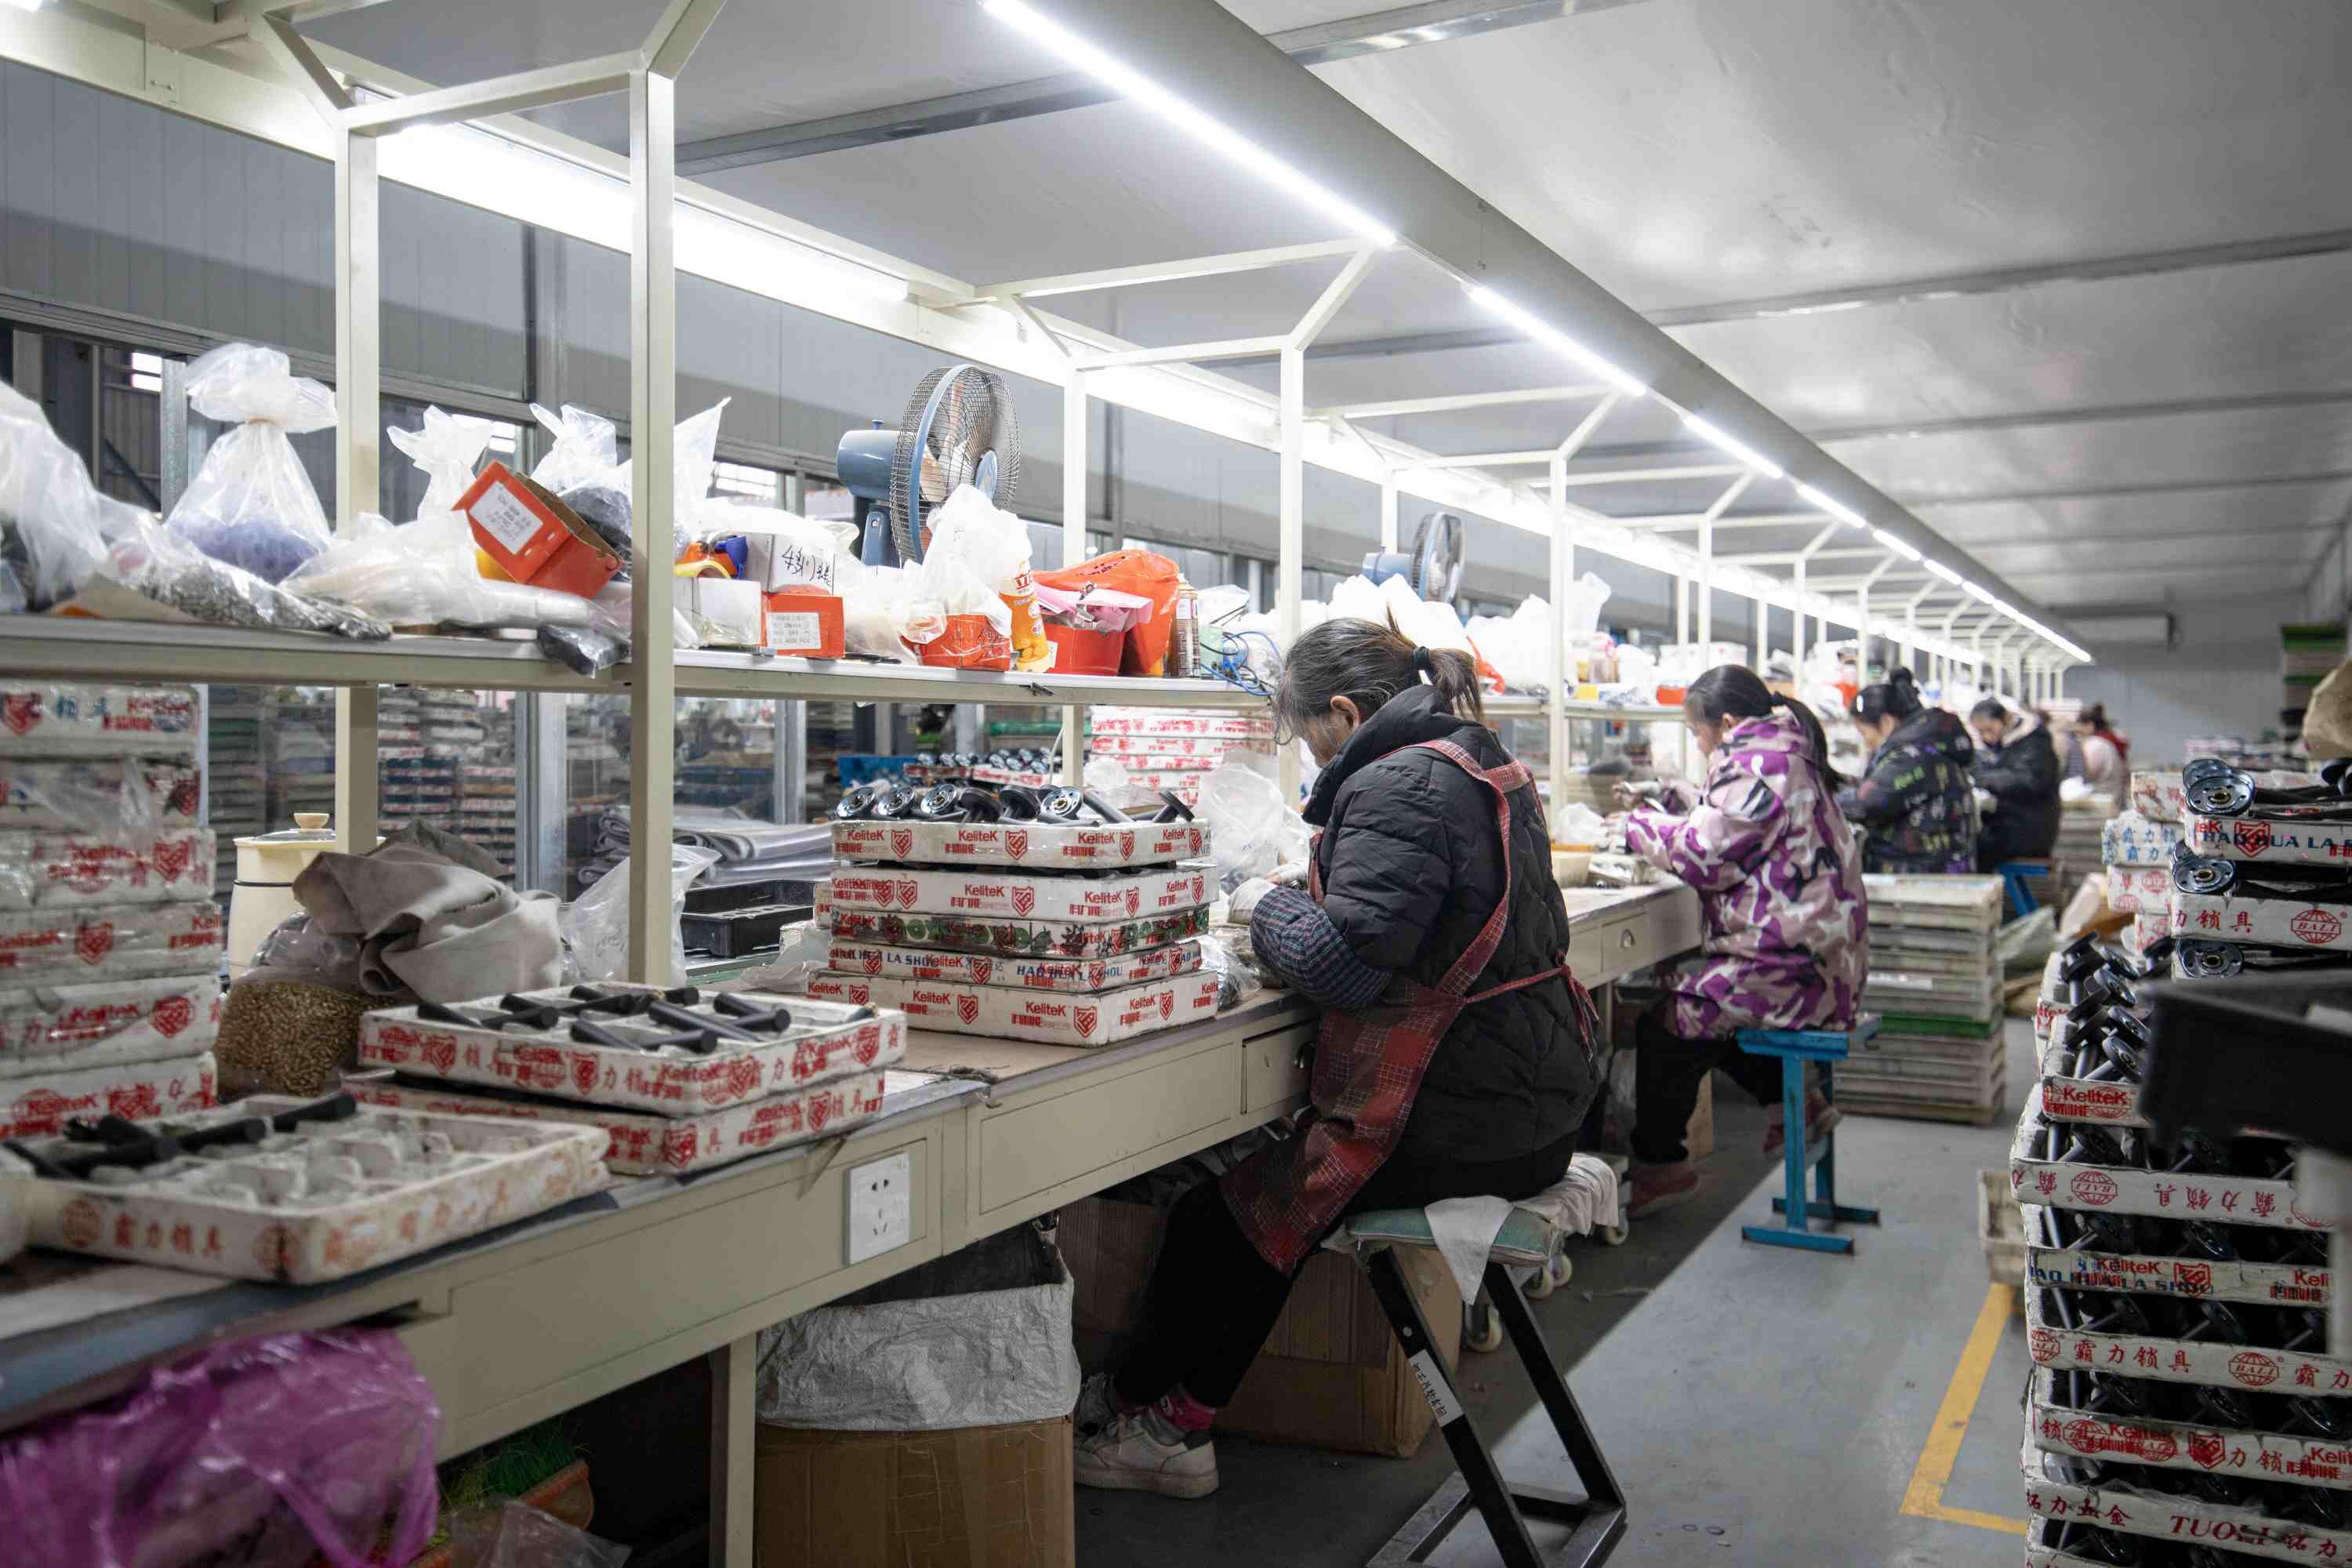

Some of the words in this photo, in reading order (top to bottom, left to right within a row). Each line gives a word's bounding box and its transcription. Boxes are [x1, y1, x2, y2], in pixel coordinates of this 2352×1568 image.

[848, 829, 885, 841] KeliteK
[959, 829, 998, 842] KeliteK
[1078, 831, 1116, 844] KeliteK
[965, 884, 1004, 898] KeliteK
[1084, 891, 1122, 904] KeliteK
[2297, 921, 2336, 932] BALI
[808, 982, 843, 995] KeliteK
[913, 990, 951, 1004] KeliteK
[1129, 994, 1156, 1011] KeliteK
[1025, 1001, 1067, 1017] KeliteK
[2063, 1087, 2129, 1105] KeliteK
[2076, 1184, 2111, 1193] BALI
[2154, 1183, 2277, 1217] 霸力锁具
[2074, 1339, 2192, 1374] 霸力锁具
[2235, 1364, 2274, 1376] BALI
[2295, 1360, 2351, 1389] 霸力
